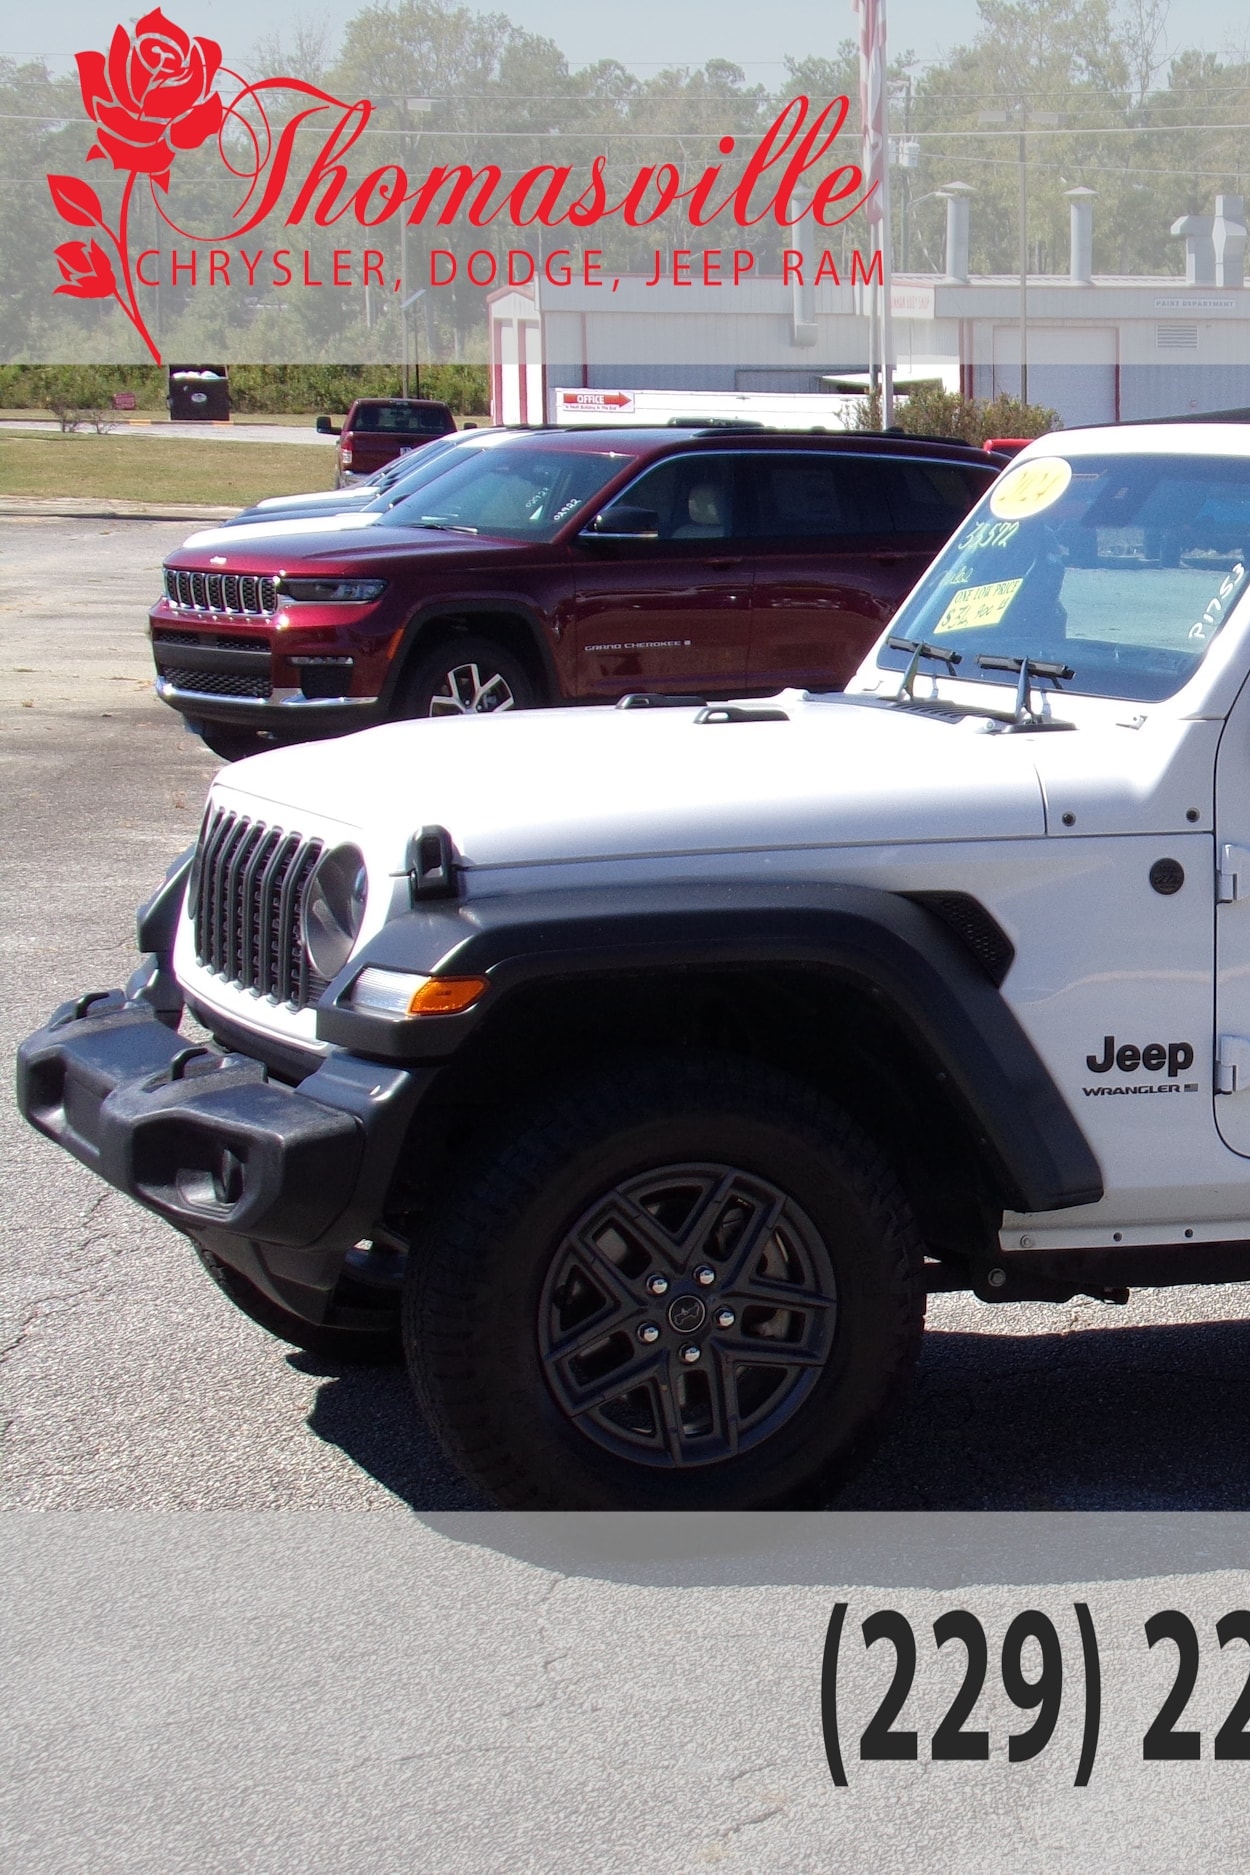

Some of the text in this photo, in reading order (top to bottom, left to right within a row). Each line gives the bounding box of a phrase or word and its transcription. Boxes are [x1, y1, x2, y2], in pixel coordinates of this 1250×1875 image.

[577, 394, 605, 404] OFFICE
[584, 640, 681, 651] GRAND CHEROKEE
[1086, 1035, 1194, 1078] Jeep
[1082, 1084, 1181, 1097] WRANGLER
